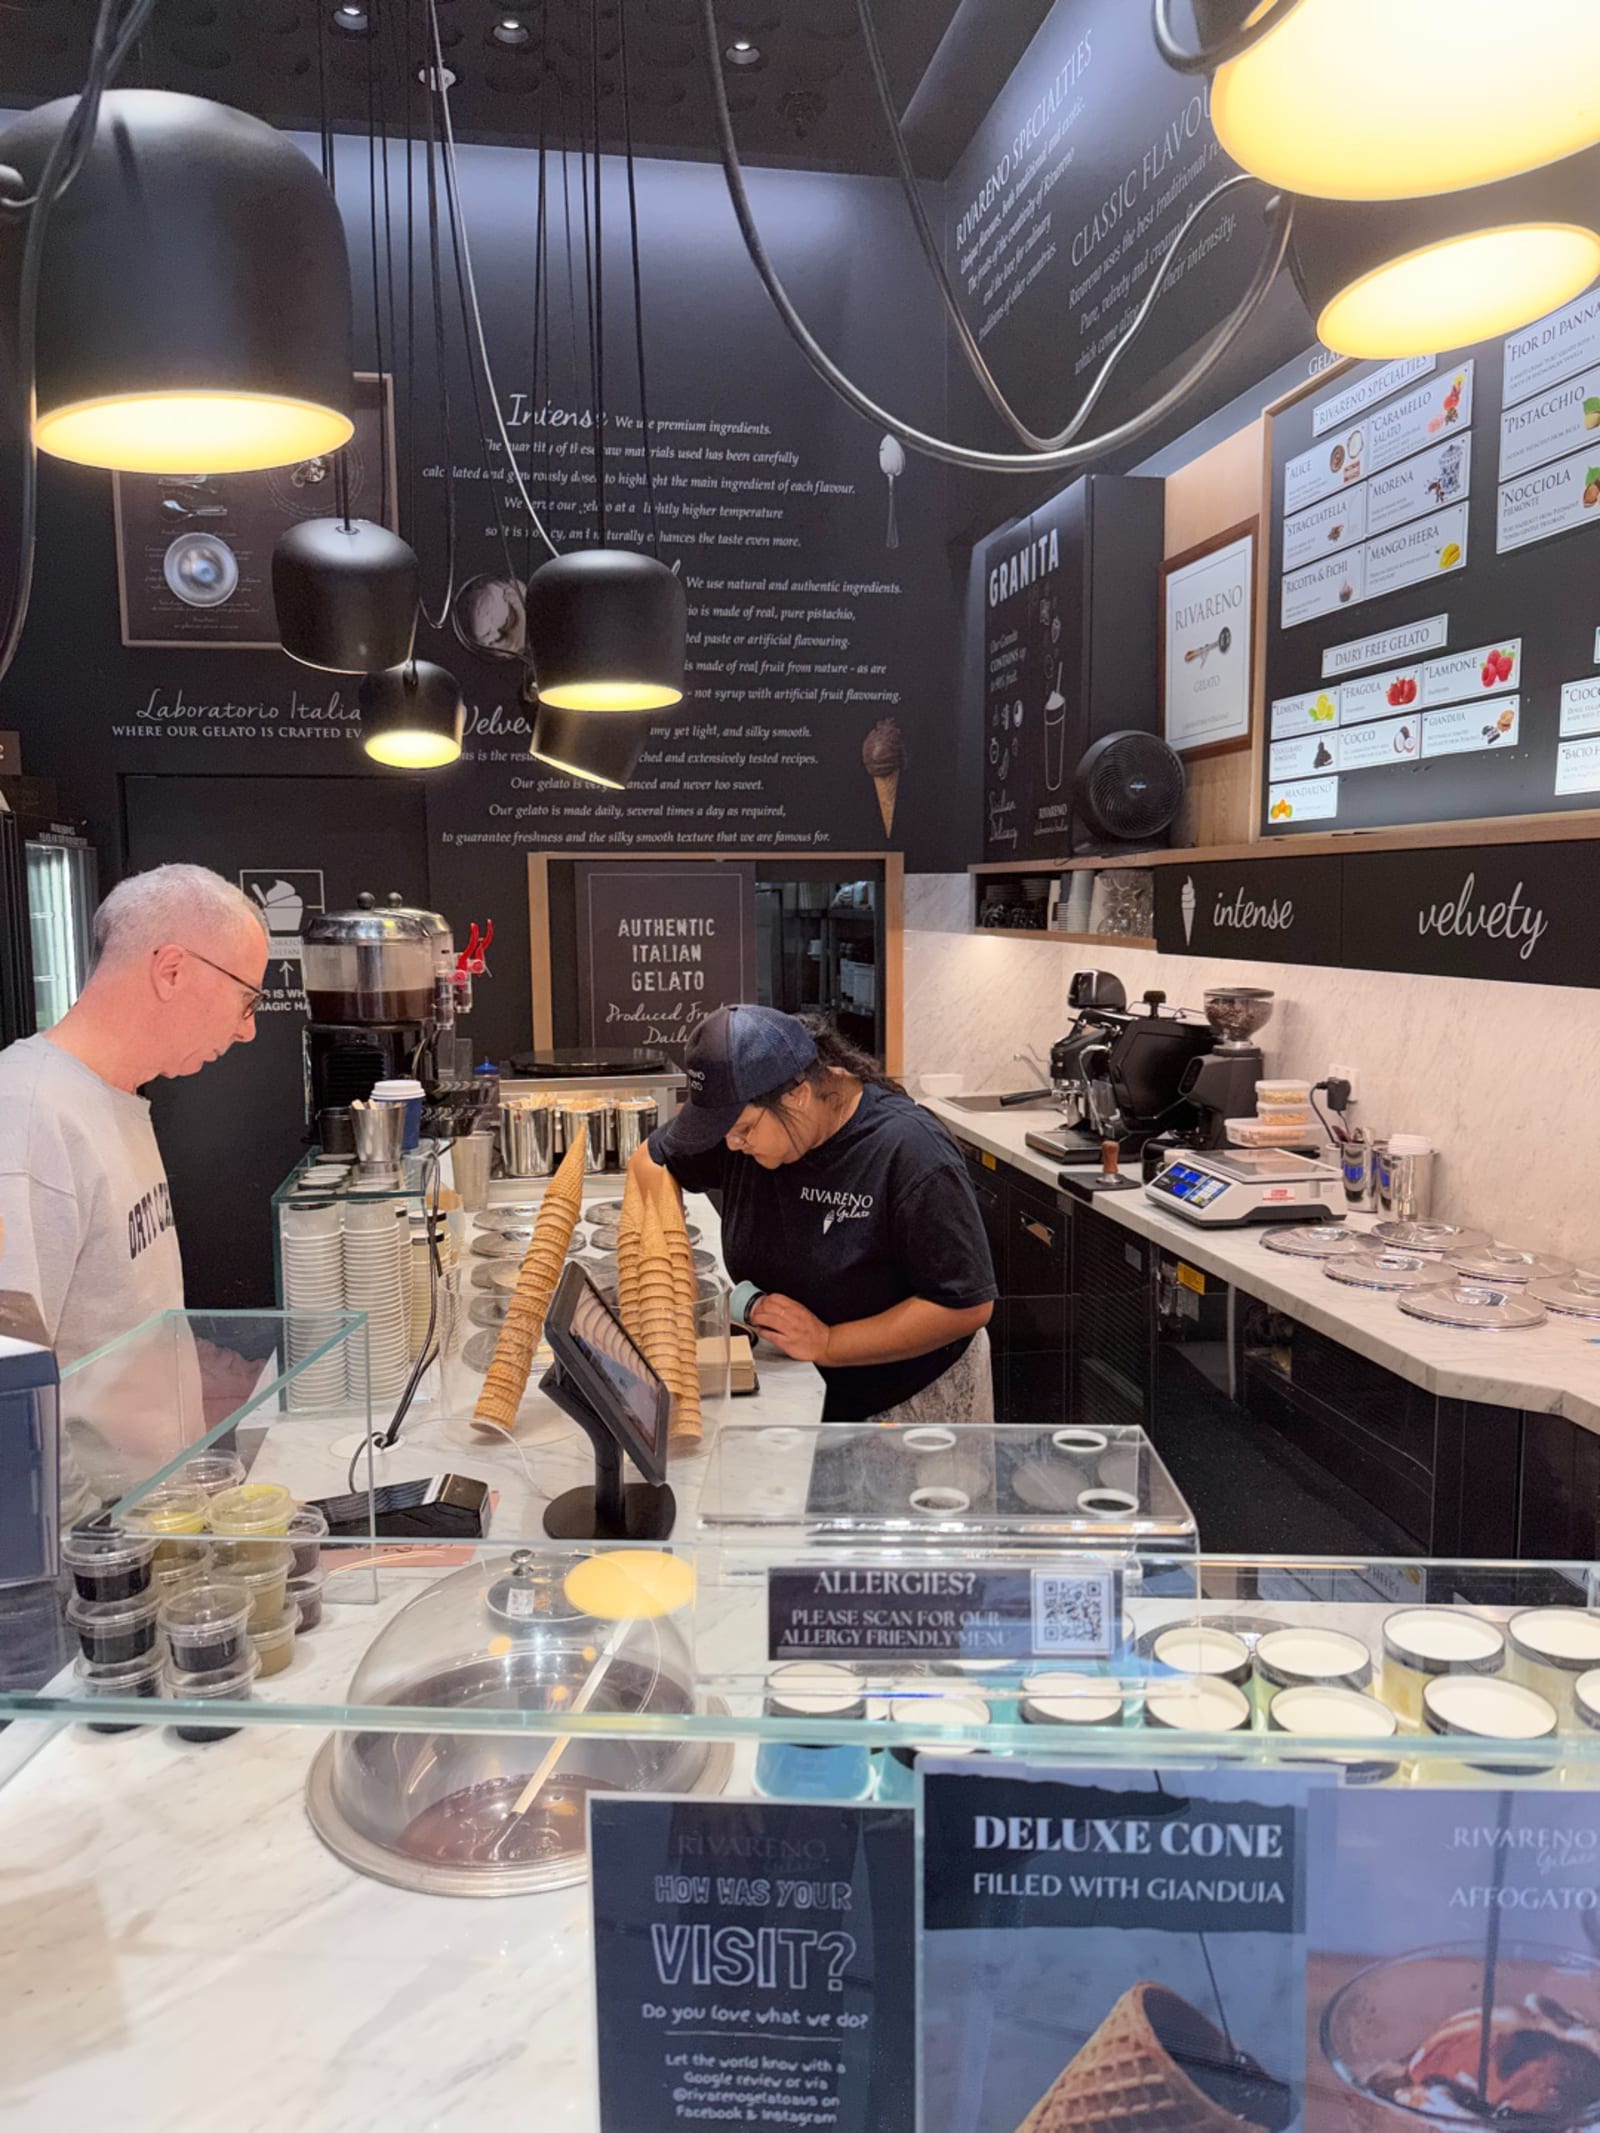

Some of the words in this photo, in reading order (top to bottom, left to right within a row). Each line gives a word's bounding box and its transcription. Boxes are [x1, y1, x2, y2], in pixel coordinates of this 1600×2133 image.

[1136, 207, 1154, 238] best
[1155, 144, 1208, 217] traditional
[956, 155, 1009, 250] RIVARENO
[1072, 169, 1137, 266] CLASSIC
[1511, 335, 1539, 362] FIOR
[1542, 326, 1556, 345] DI
[1319, 388, 1366, 426] RIVARENO
[1373, 390, 1432, 432] CARAMELLO
[1507, 385, 1585, 433] PISTACCHIO
[657, 419, 706, 434] premium
[709, 420, 772, 437] ingredients.
[678, 448, 701, 460] used
[705, 449, 723, 461] has
[726, 449, 750, 462] been
[753, 451, 799, 467] carefully
[671, 474, 688, 487] the
[691, 476, 718, 489] main
[721, 477, 775, 492] ingredient
[790, 479, 813, 492] each
[814, 480, 855, 495] flavour.
[1372, 470, 1415, 498] MORENA
[1504, 468, 1572, 507] NOCCIOLA
[682, 503, 717, 519] higher
[720, 506, 783, 523] temperature
[1287, 501, 1347, 537] STRACCIATELLA
[699, 532, 715, 545] the
[718, 533, 743, 545] taste
[773, 537, 801, 547] more.
[1369, 535, 1407, 563] MANGO
[1407, 524, 1440, 550] HEERA
[989, 528, 1059, 608] GRANITA
[727, 578, 766, 590] natural
[769, 579, 789, 591] and
[791, 580, 840, 593] authentic
[842, 581, 902, 597] ingredients.
[713, 605, 740, 617] made
[807, 608, 856, 622] pistachio,
[1175, 584, 1243, 632] RIVARENO
[704, 634, 732, 647] paste
[747, 633, 791, 648] artificial
[1335, 649, 1361, 666] DAIRY
[1365, 640, 1387, 658] FREE
[1389, 628, 1429, 650] GELATO
[696, 661, 723, 672] made
[814, 664, 848, 674] nature
[1428, 656, 1478, 679] LAMPONE
[1346, 683, 1381, 699] FRAGOLA
[136, 688, 280, 721] Laboratorio
[112, 725, 163, 737] WHERE
[167, 725, 199, 737] OUR
[202, 726, 256, 738] GELATO
[261, 726, 274, 738] IS
[278, 726, 340, 739] CRAFTED
[723, 726, 743, 738] and
[745, 726, 770, 741] silky
[772, 727, 812, 738] smooth.
[1344, 730, 1376, 745] COCCO
[665, 753, 685, 764] and
[687, 753, 746, 767] extensively
[749, 753, 779, 764] tested
[510, 777, 535, 789] Our
[537, 777, 570, 792] gelato
[660, 780, 680, 790] and
[489, 803, 513, 816] Our
[515, 804, 549, 819] gelato
[564, 805, 592, 816] made
[627, 805, 664, 816] several
[666, 805, 694, 816] times
[706, 805, 725, 819] day
[741, 805, 786, 819] required,
[456, 833, 511, 846] guarantee
[512, 831, 563, 846] freshness
[565, 831, 586, 843] and
[588, 831, 607, 843] the
[608, 831, 633, 846] silky
[636, 831, 674, 843] smooth
[677, 831, 714, 843] texture
[716, 831, 738, 843] that
[1213, 886, 1294, 930] intense
[1418, 871, 1549, 961] velvety
[617, 918, 715, 937] AUTHENTIC
[632, 944, 702, 963] ITALIAN
[631, 970, 705, 992] GELATO
[273, 989, 284, 998] IS
[605, 1002, 683, 1023] Produced
[800, 1185, 874, 1209] RIVARENO
[835, 1206, 871, 1223] Gelato
[813, 1570, 976, 1596] ALLERGIES?
[792, 1609, 860, 1626] PLEASE
[863, 1610, 914, 1626] SCAN
[917, 1610, 956, 1627] FOR
[960, 1611, 1000, 1627] OUR
[780, 1629, 862, 1646] ALLERGY
[866, 1629, 953, 1646] FRIENDLY
[972, 1815, 1151, 1855] DELUXE
[1159, 1821, 1283, 1859] CONE
[1451, 1826, 1597, 1850] RIVARENO
[654, 1874, 711, 1905] HOW
[716, 1877, 771, 1907] WAS
[776, 1879, 852, 1911] YOUR
[972, 1872, 1063, 1898] FILLED
[1068, 1875, 1139, 1900] WITH
[1146, 1878, 1286, 1904] GIANDUIA
[1449, 1886, 1598, 1911] AFFOGATO
[650, 1922, 857, 1992] VISIT?
[641, 2002, 667, 2019] Do
[671, 2006, 706, 2025] you
[710, 2005, 751, 2023] love
[755, 2007, 801, 2026] what
[805, 2012, 831, 2028] we
[836, 2012, 869, 2030] do?
[665, 2054, 689, 2067] Let
[692, 2054, 716, 2068] the
[718, 2056, 758, 2070] world
[761, 2056, 799, 2072] know
[801, 2058, 832, 2073] with
[836, 2063, 846, 2074] a
[683, 2071, 733, 2089] Google
[735, 2074, 783, 2088] review
[785, 2075, 802, 2089] or
[804, 2077, 829, 2090] via
[821, 2096, 840, 2107] on
[676, 2104, 743, 2121] Facebook
[761, 2108, 837, 2127] Instagram
